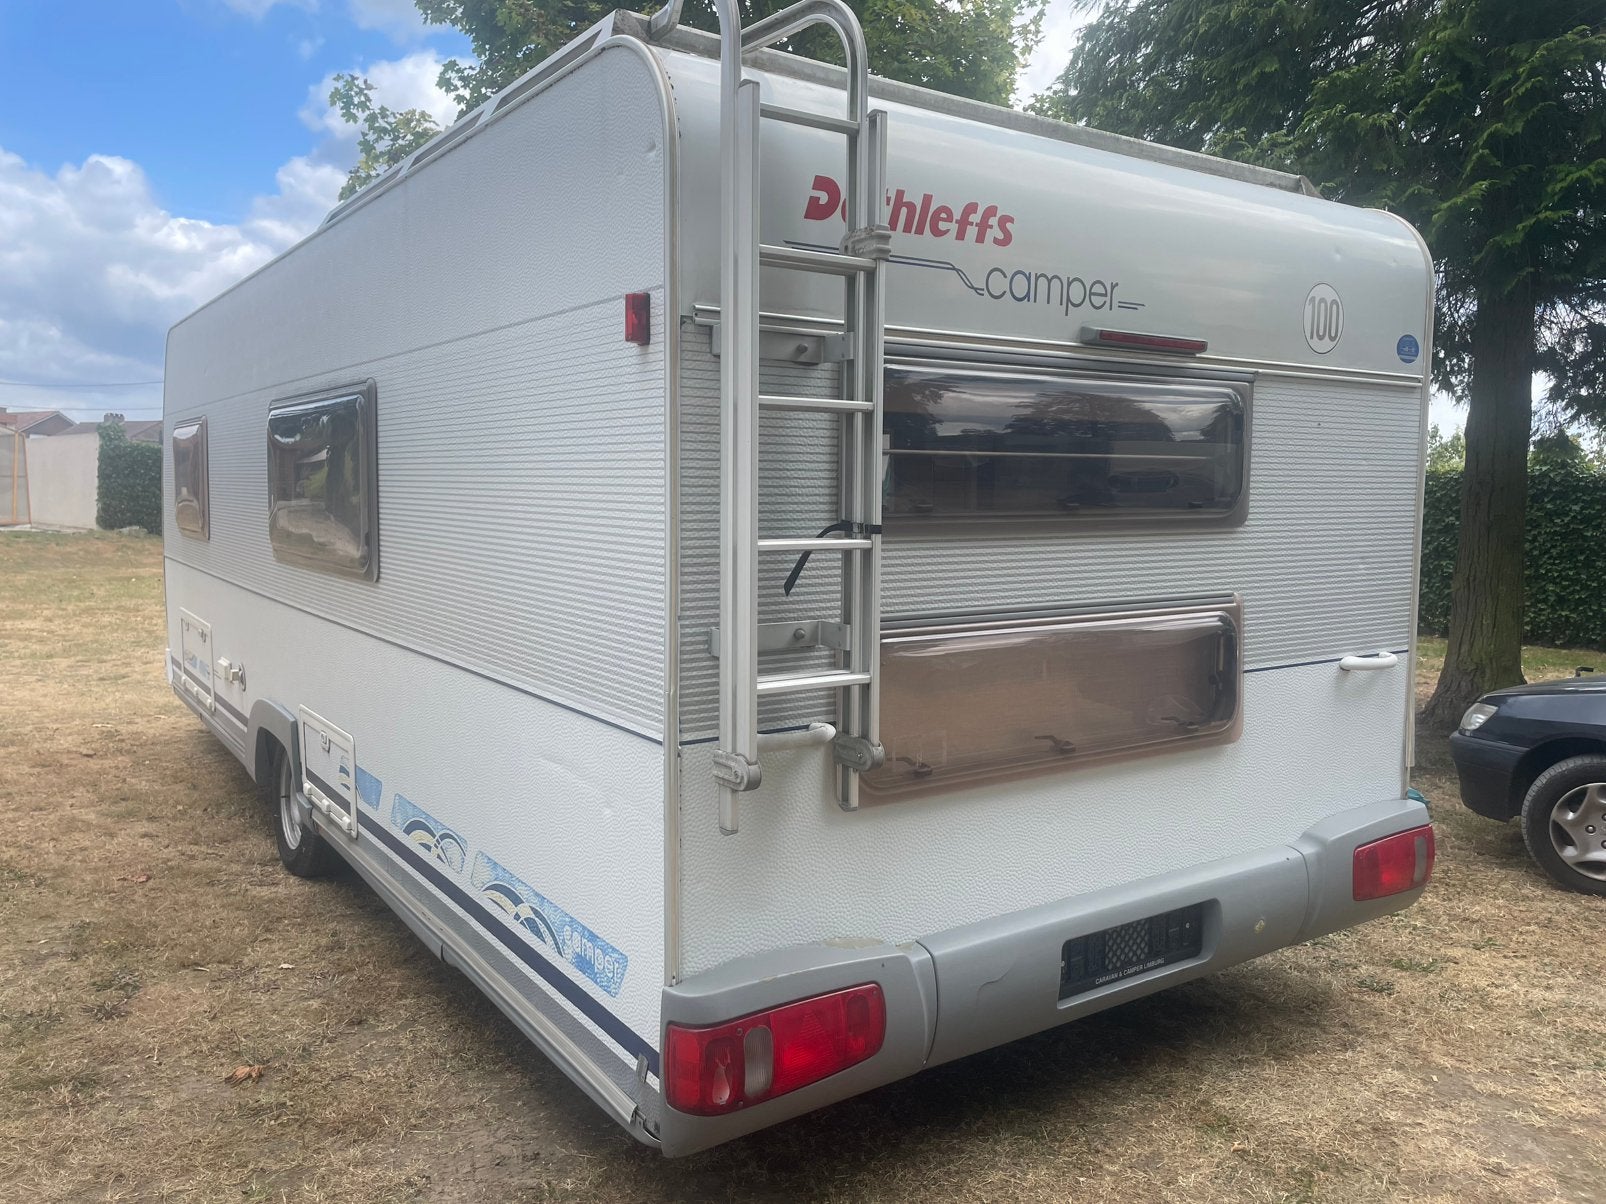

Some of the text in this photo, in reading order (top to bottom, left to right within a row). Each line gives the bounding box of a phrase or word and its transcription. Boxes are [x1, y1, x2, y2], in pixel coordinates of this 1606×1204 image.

[804, 175, 1015, 247] Dhleffs
[985, 267, 1119, 316] camper
[1308, 295, 1340, 342] 100
[1095, 972, 1118, 984] CARAVAN
[1123, 964, 1143, 975] CAMPER
